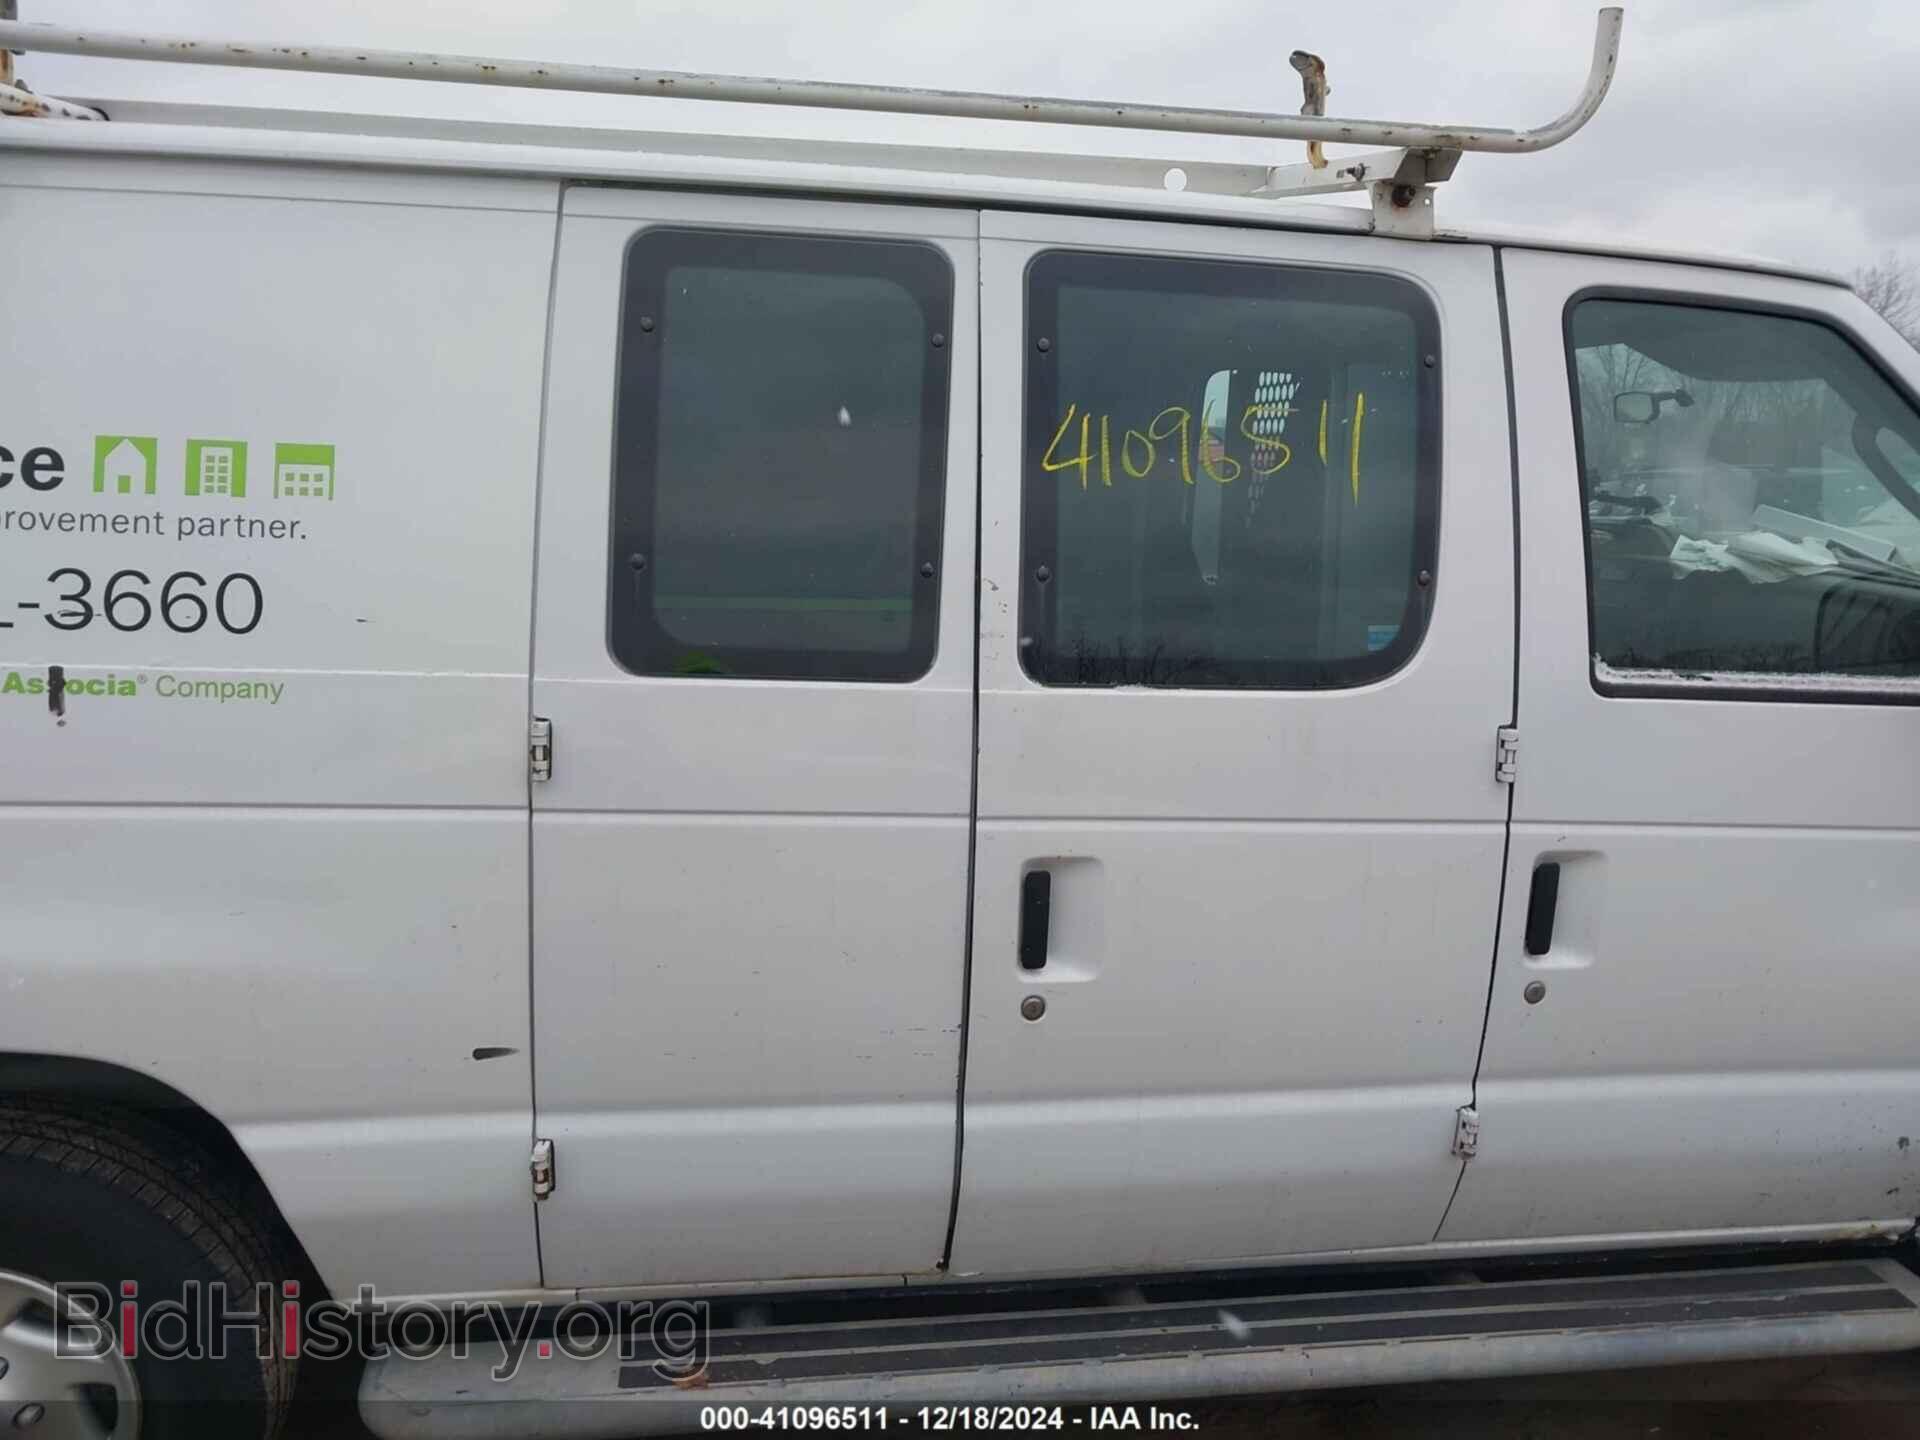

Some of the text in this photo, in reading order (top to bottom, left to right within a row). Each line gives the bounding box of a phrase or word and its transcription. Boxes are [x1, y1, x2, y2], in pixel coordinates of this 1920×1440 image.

[1041, 392, 1366, 505] 41096511
[0, 510, 307, 541] rovement partner.
[0, 567, 264, 634] -3660
[155, 674, 285, 704] Company
